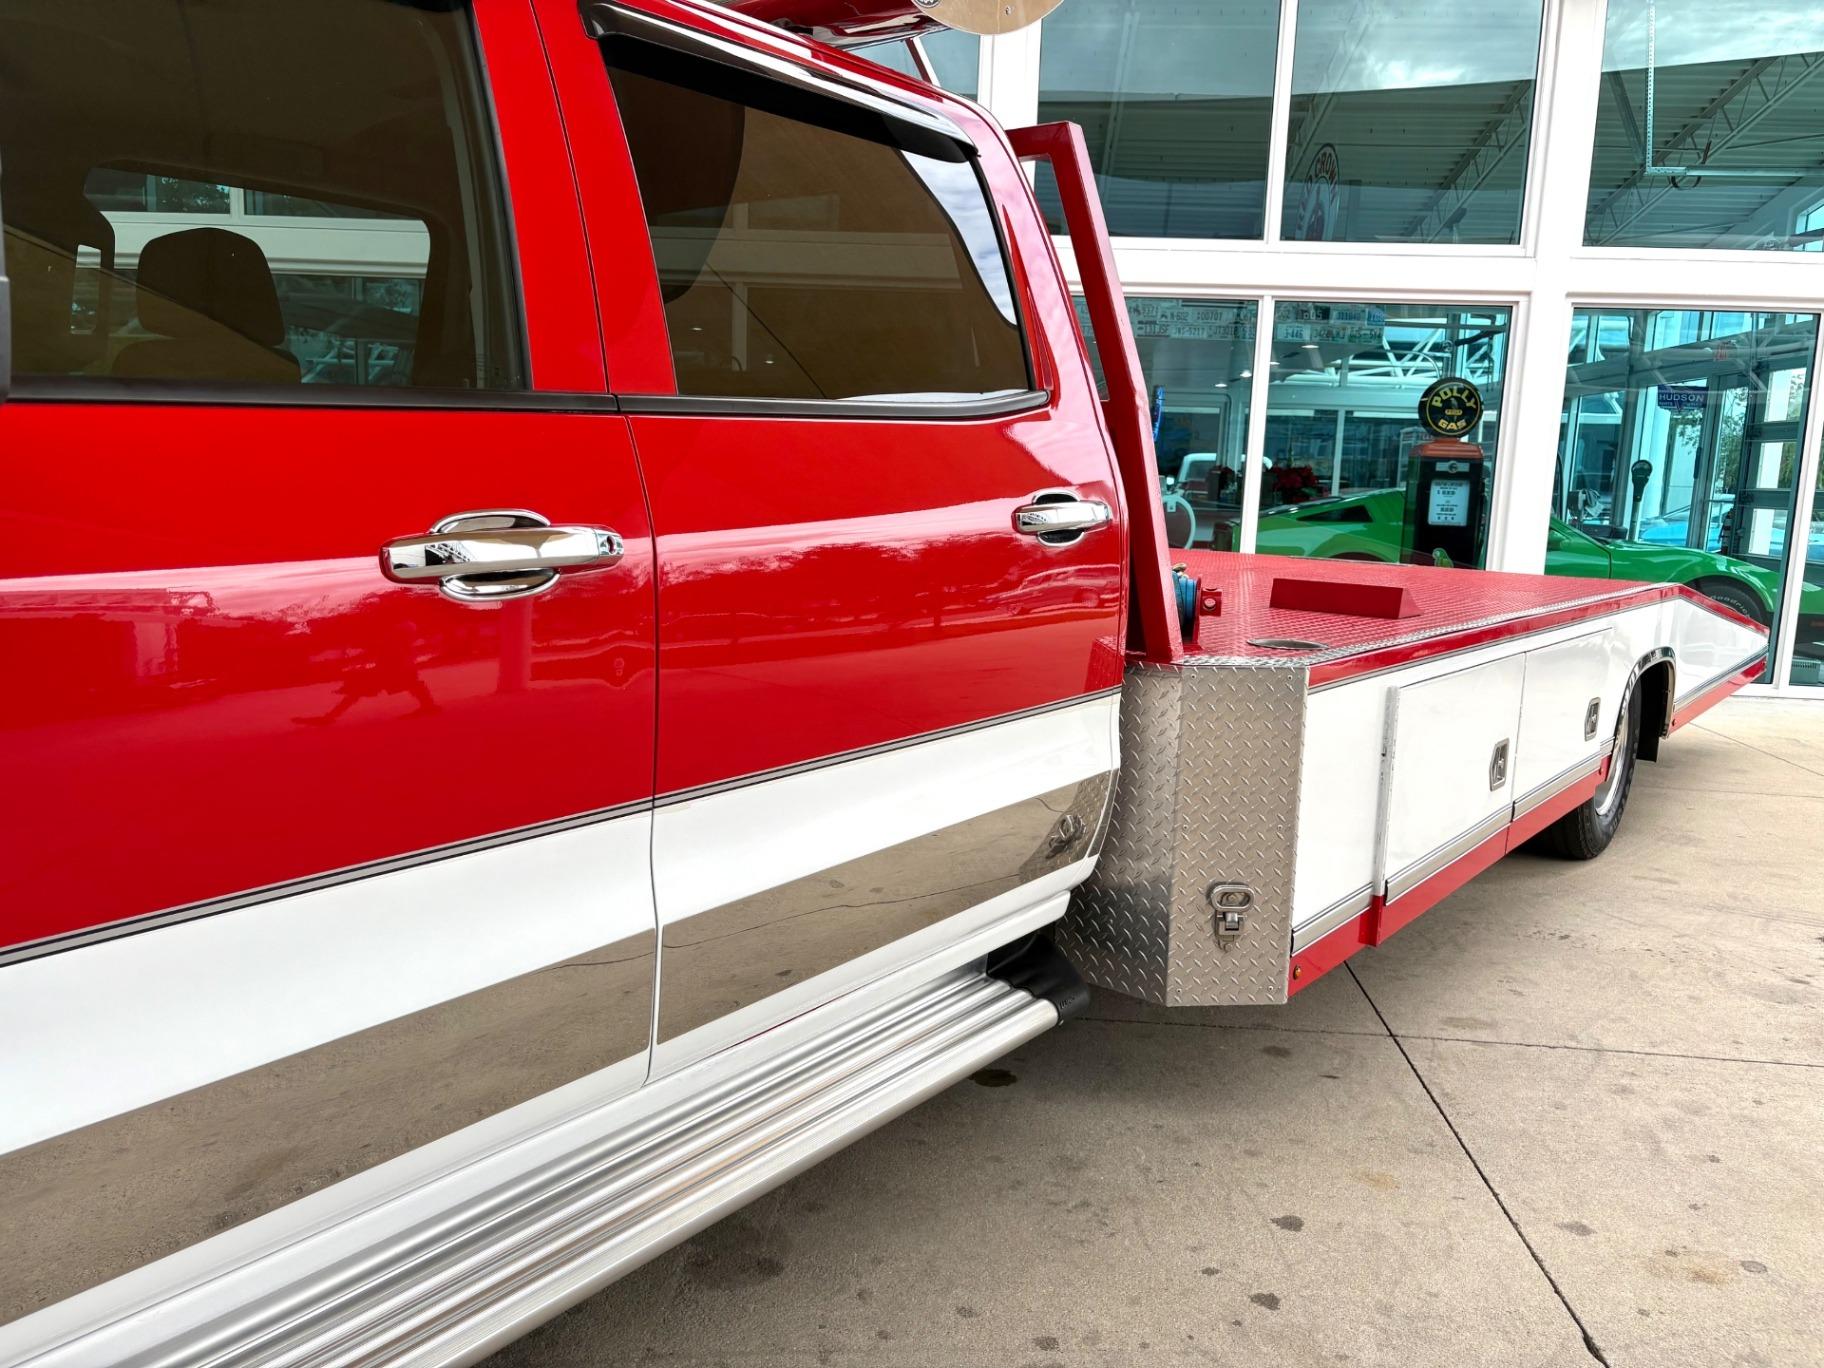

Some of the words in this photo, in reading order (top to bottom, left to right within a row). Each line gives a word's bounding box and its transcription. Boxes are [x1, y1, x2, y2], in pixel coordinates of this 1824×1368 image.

[1431, 386, 1477, 409] POLLY
[1659, 393, 1705, 402] HUDSON
[1438, 418, 1467, 430] GAS
